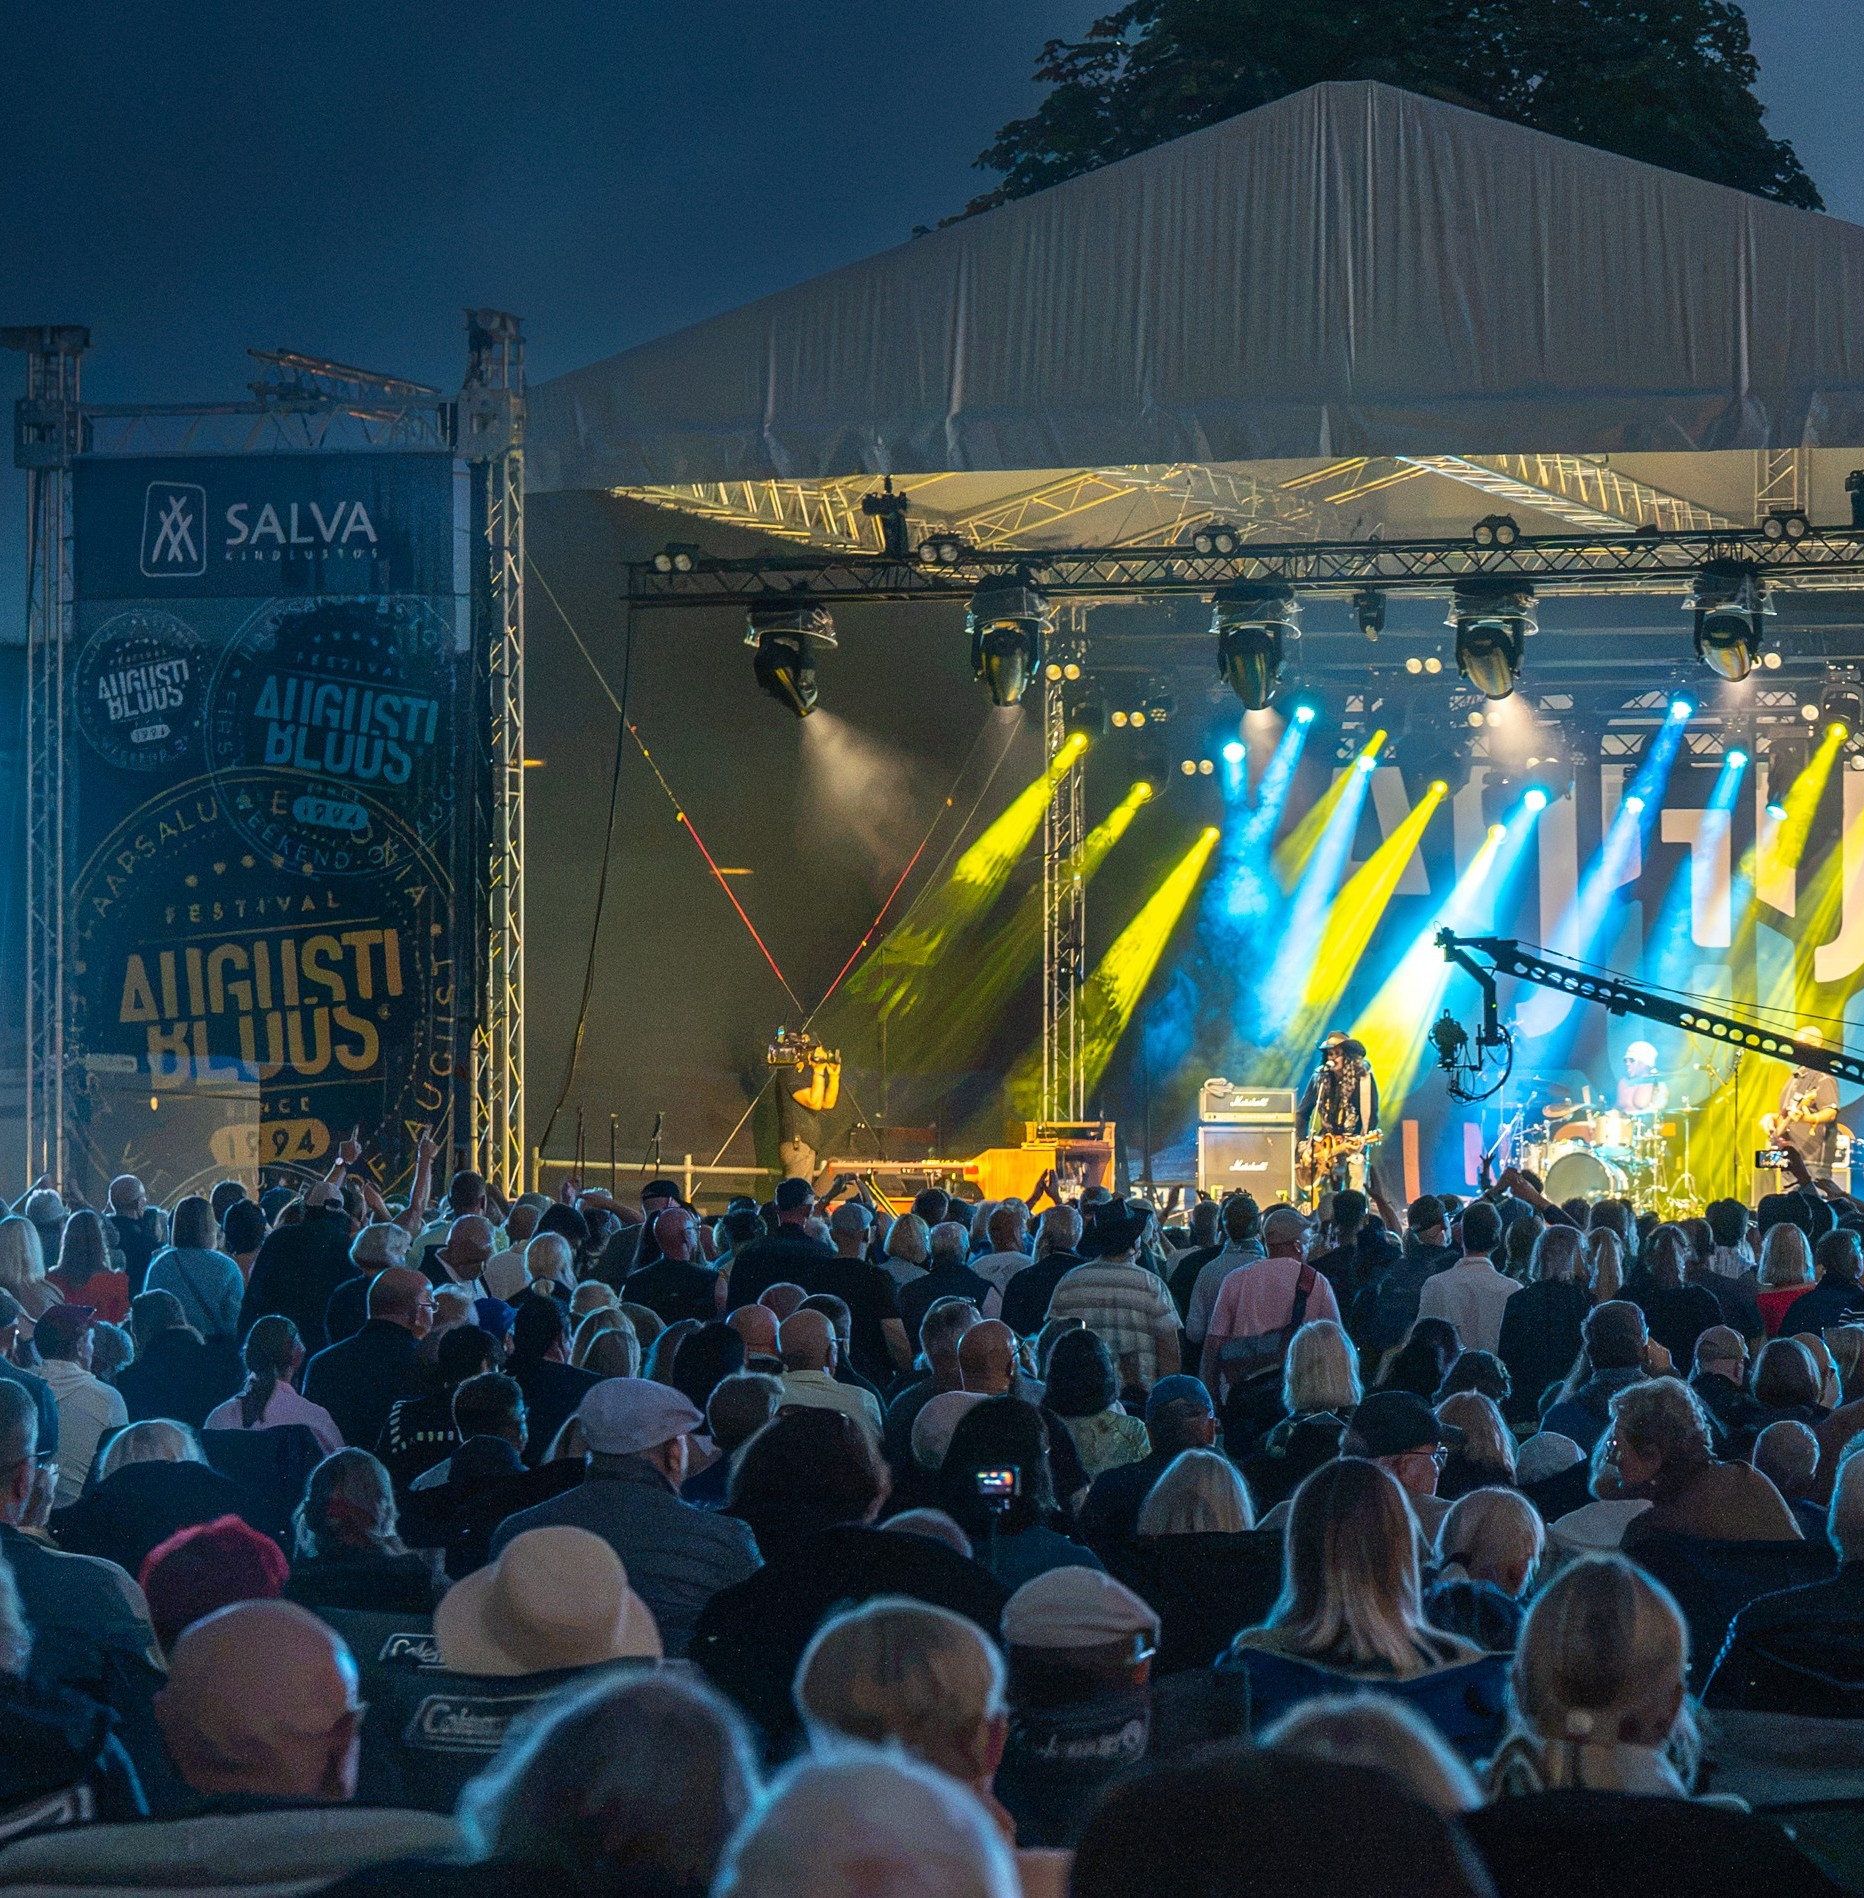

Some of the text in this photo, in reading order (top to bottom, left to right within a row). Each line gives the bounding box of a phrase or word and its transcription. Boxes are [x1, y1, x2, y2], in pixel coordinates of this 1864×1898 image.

[225, 500, 379, 545] SALVA
[254, 674, 439, 744] AUGUSTI
[165, 887, 341, 925] FESTIVAL
[119, 928, 404, 1023] AUGUSTI
[1229, 1095, 1270, 1107] Marshall
[226, 1124, 319, 1160] 1994
[1228, 1159, 1268, 1171] Marshall
